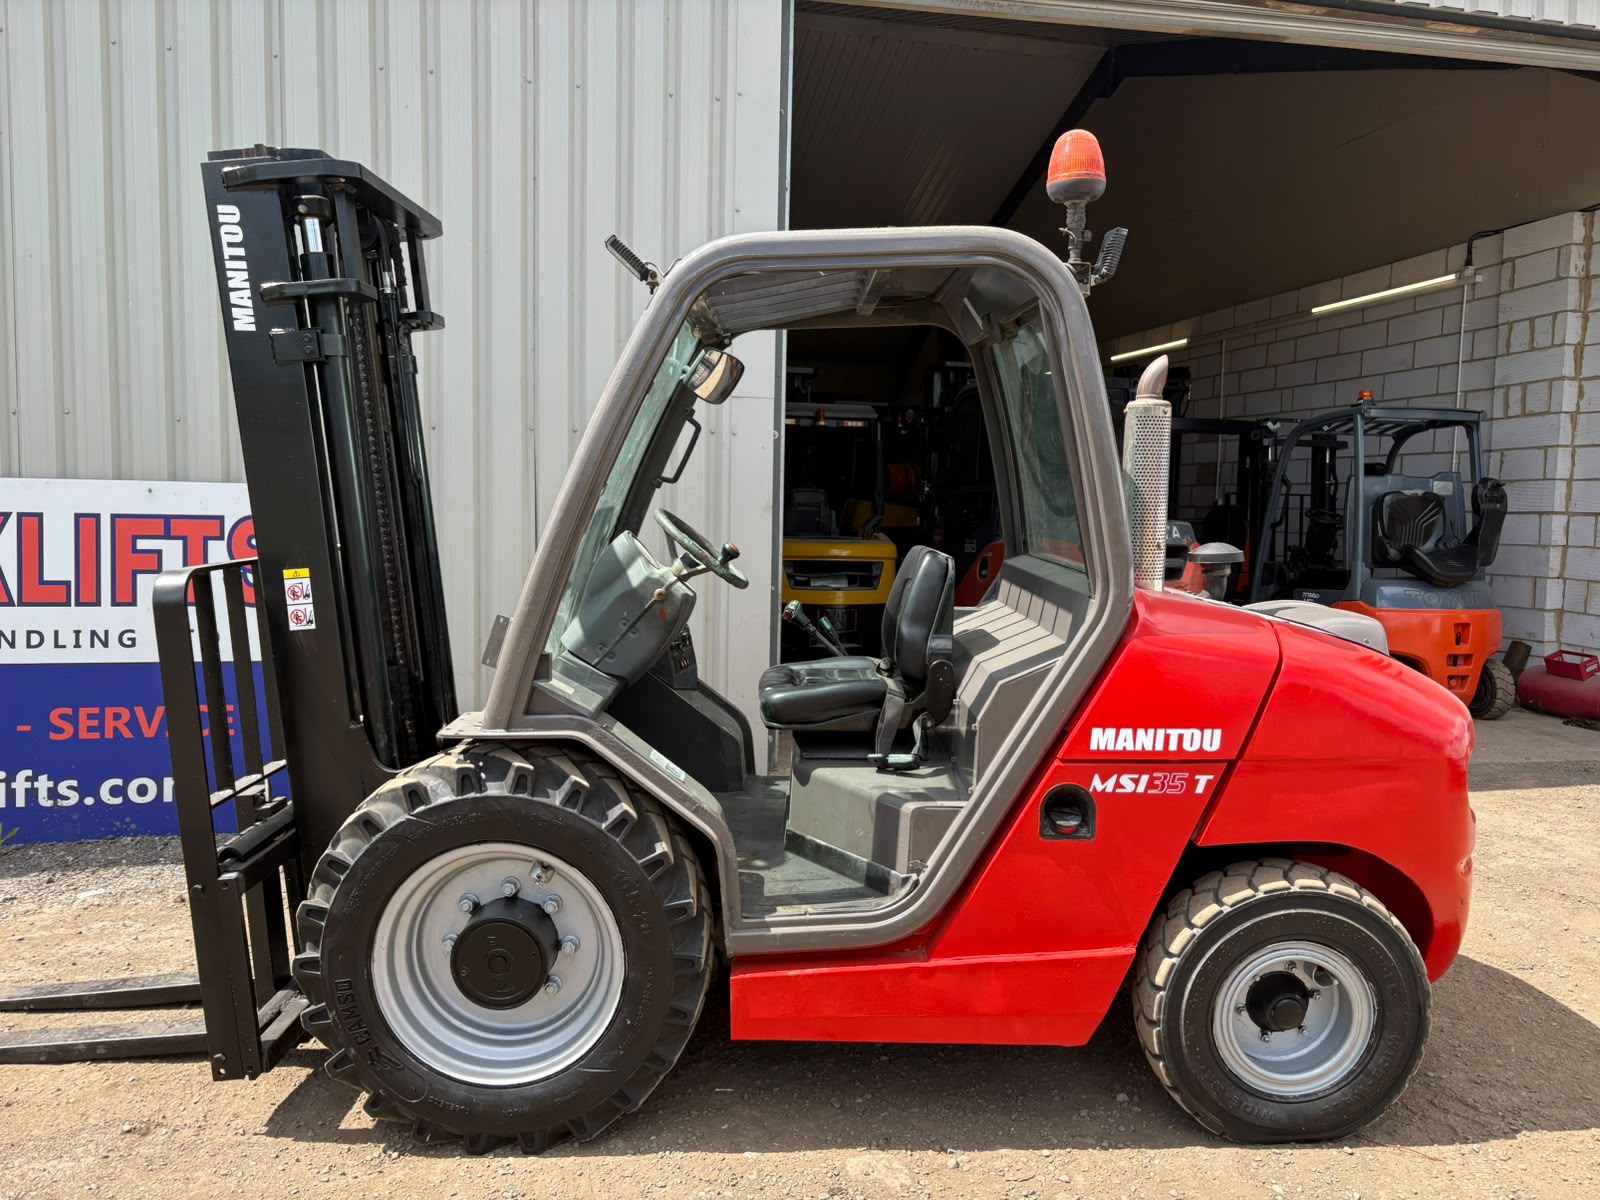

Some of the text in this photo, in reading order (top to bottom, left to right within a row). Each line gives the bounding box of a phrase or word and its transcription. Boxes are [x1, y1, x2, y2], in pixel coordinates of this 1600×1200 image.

[217, 204, 257, 332] MANITOU
[1089, 727, 1222, 752] MANITOU
[1194, 775, 1214, 794] T
